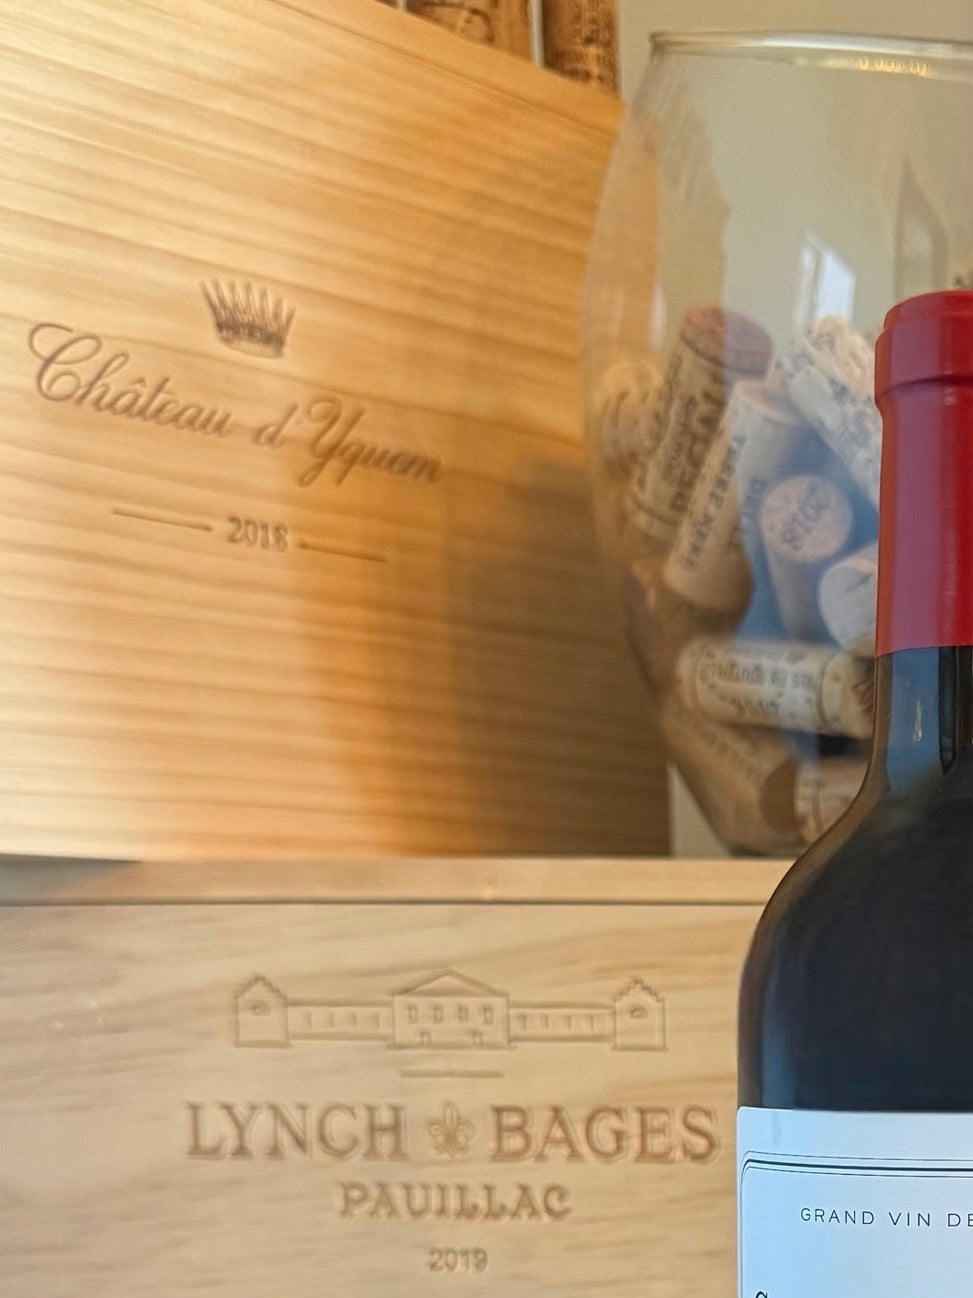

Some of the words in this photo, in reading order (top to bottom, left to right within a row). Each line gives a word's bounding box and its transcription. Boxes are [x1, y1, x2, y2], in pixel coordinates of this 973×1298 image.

[27, 322, 232, 439] Château
[185, 1102, 410, 1162] LYNCH
[489, 1103, 721, 1164] BAGES
[338, 1181, 573, 1221] PAUILLAC
[800, 1207, 875, 1226] GRAND
[887, 1210, 931, 1227] VIN
[427, 1248, 488, 1273] 2019
